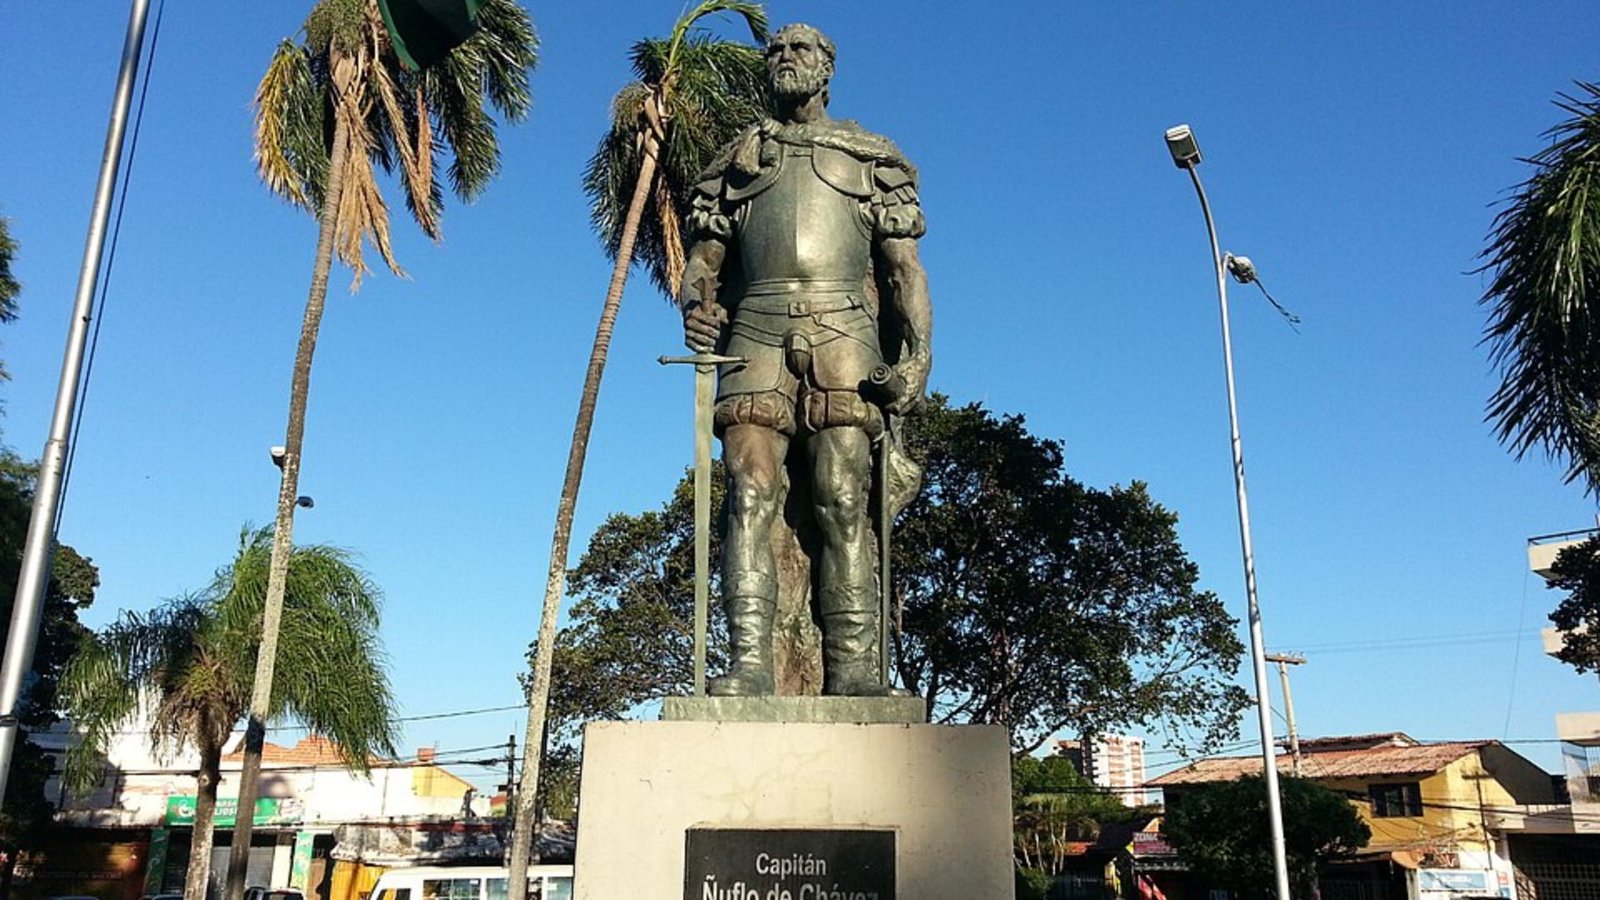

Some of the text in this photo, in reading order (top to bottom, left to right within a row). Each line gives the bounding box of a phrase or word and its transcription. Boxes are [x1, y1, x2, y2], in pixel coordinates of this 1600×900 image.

[756, 852, 827, 880] Capitán
[702, 874, 759, 900] Ñuflo
[766, 882, 792, 900] de
